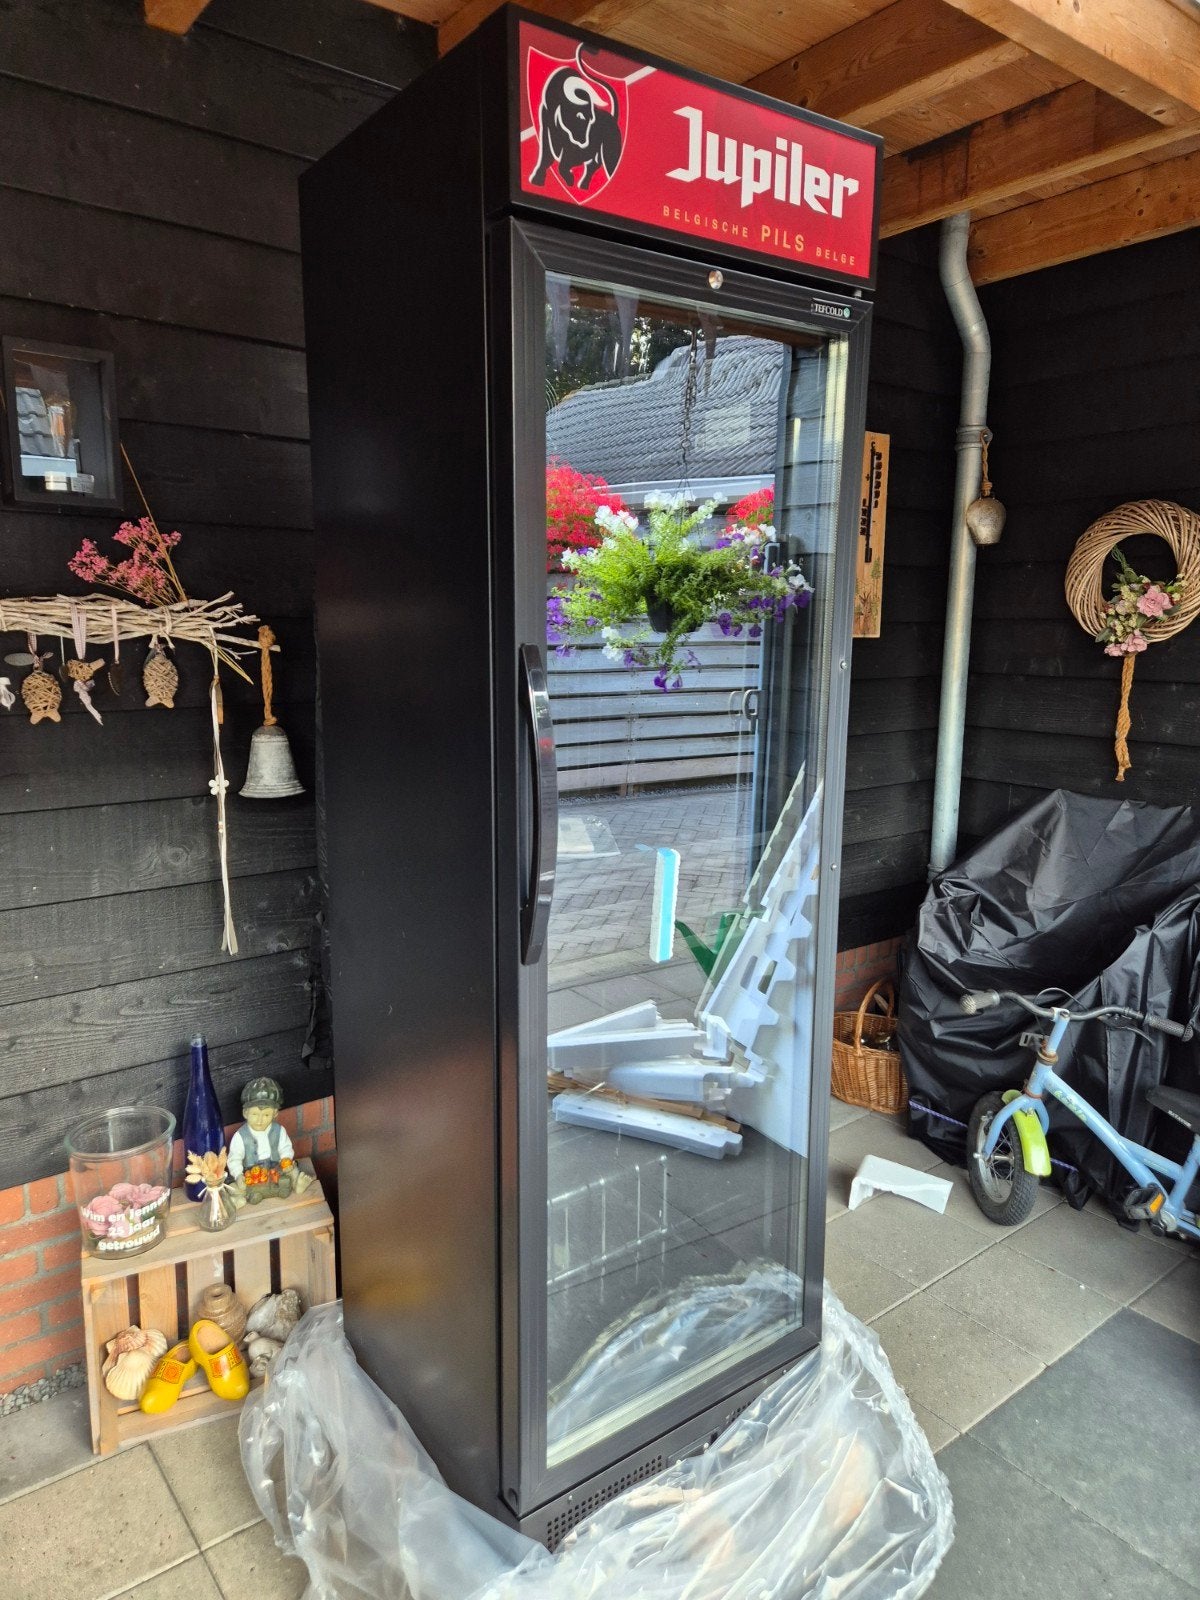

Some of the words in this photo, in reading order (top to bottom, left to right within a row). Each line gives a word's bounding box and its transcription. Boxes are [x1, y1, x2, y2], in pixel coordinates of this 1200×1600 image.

[665, 105, 860, 219] Jupiler
[663, 205, 748, 238] BELGISCHE
[761, 224, 805, 252] PILS
[815, 246, 856, 267] BELGE
[814, 303, 843, 317] TEFCOLD
[81, 1205, 105, 1222] Wim
[108, 1213, 126, 1223] en
[98, 1224, 160, 1251] getrouwd
[108, 1226, 125, 1237] 25
[128, 1216, 156, 1234] jaar
